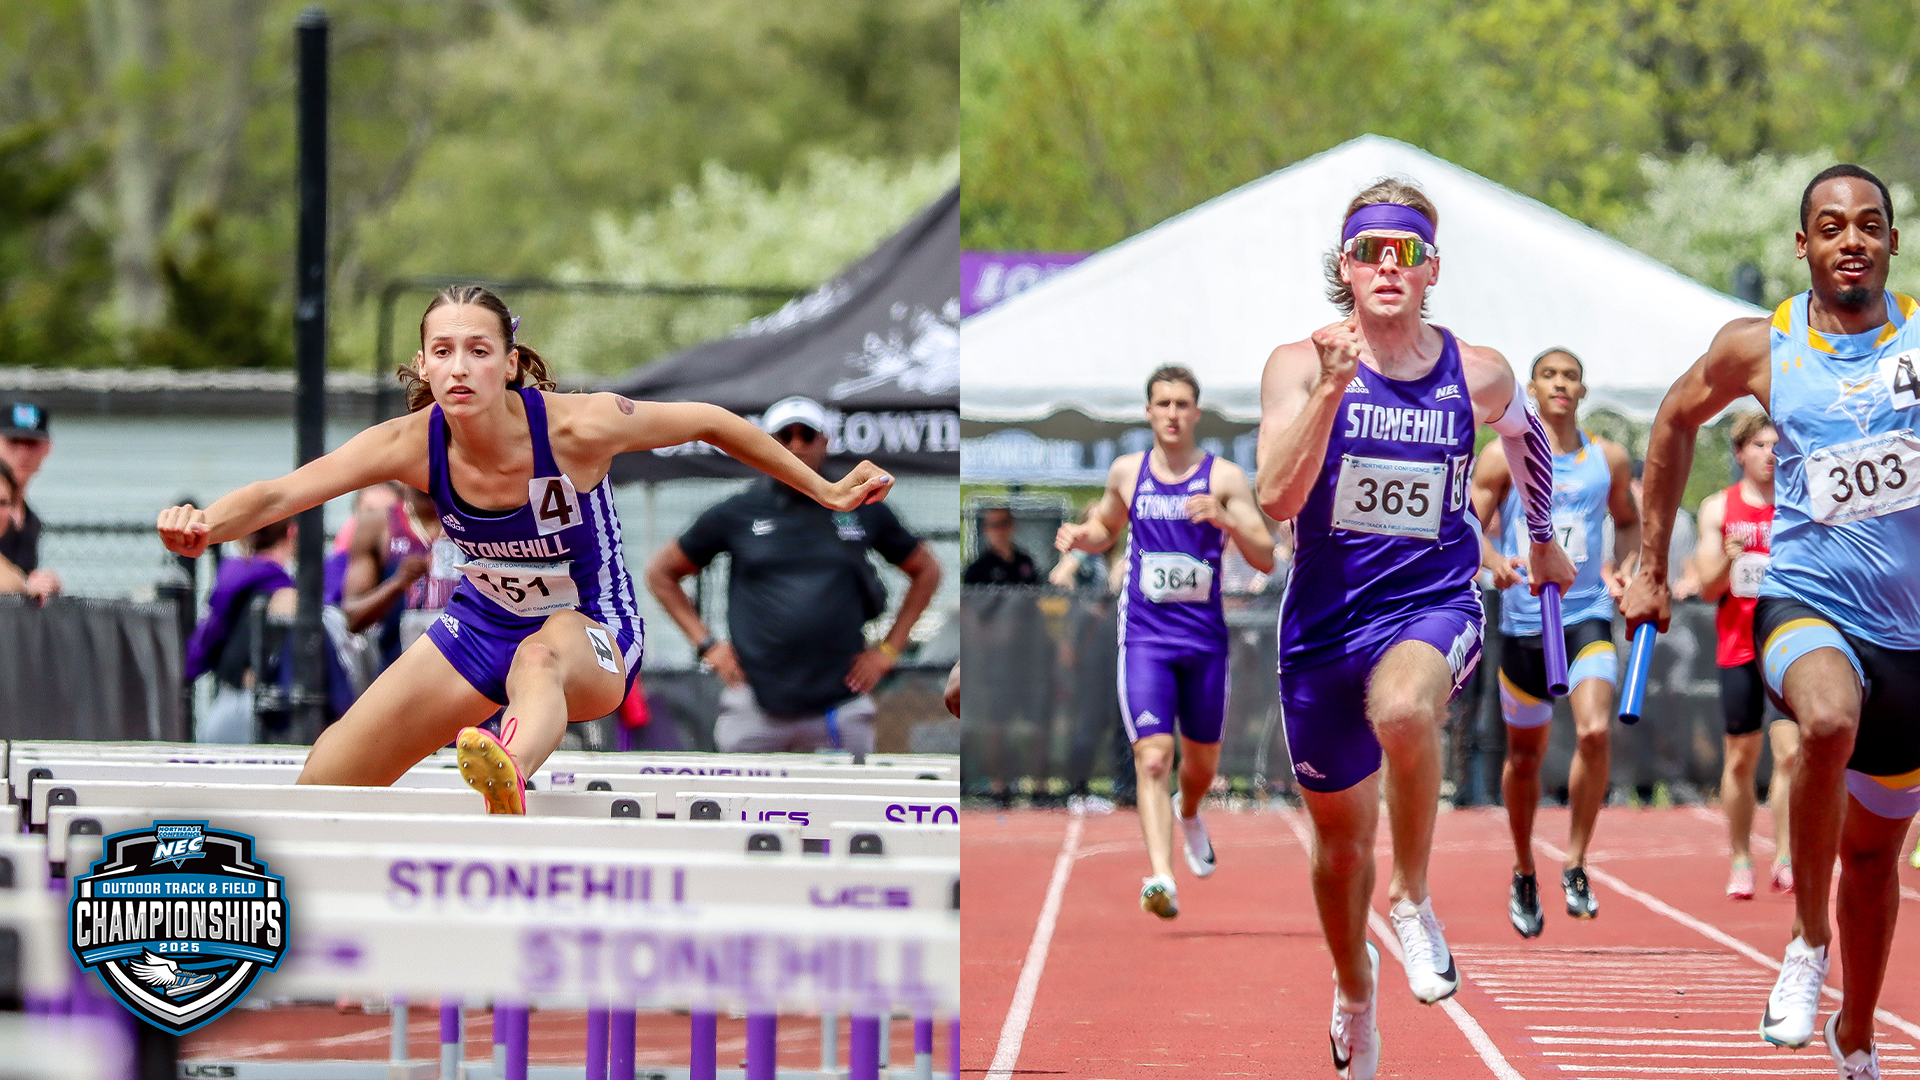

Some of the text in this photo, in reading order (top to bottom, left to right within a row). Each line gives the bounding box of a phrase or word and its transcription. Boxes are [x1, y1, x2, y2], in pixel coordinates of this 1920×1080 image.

[1435, 384, 1459, 399] NEC
[1893, 355, 1920, 400] 4
[1344, 402, 1459, 446] STONEHILL
[1355, 477, 1430, 517] 365
[1453, 458, 1467, 505] 5
[1828, 453, 1908, 503] 303
[539, 479, 574, 526] 4
[453, 534, 571, 559] STONEHILL
[476, 573, 550, 604] 151
[1153, 567, 1198, 590] 364
[589, 632, 614, 662] 4
[389, 858, 693, 905] STONEHILL
[522, 930, 940, 998] STONEHILL
[185, 1064, 236, 1078] UCS
